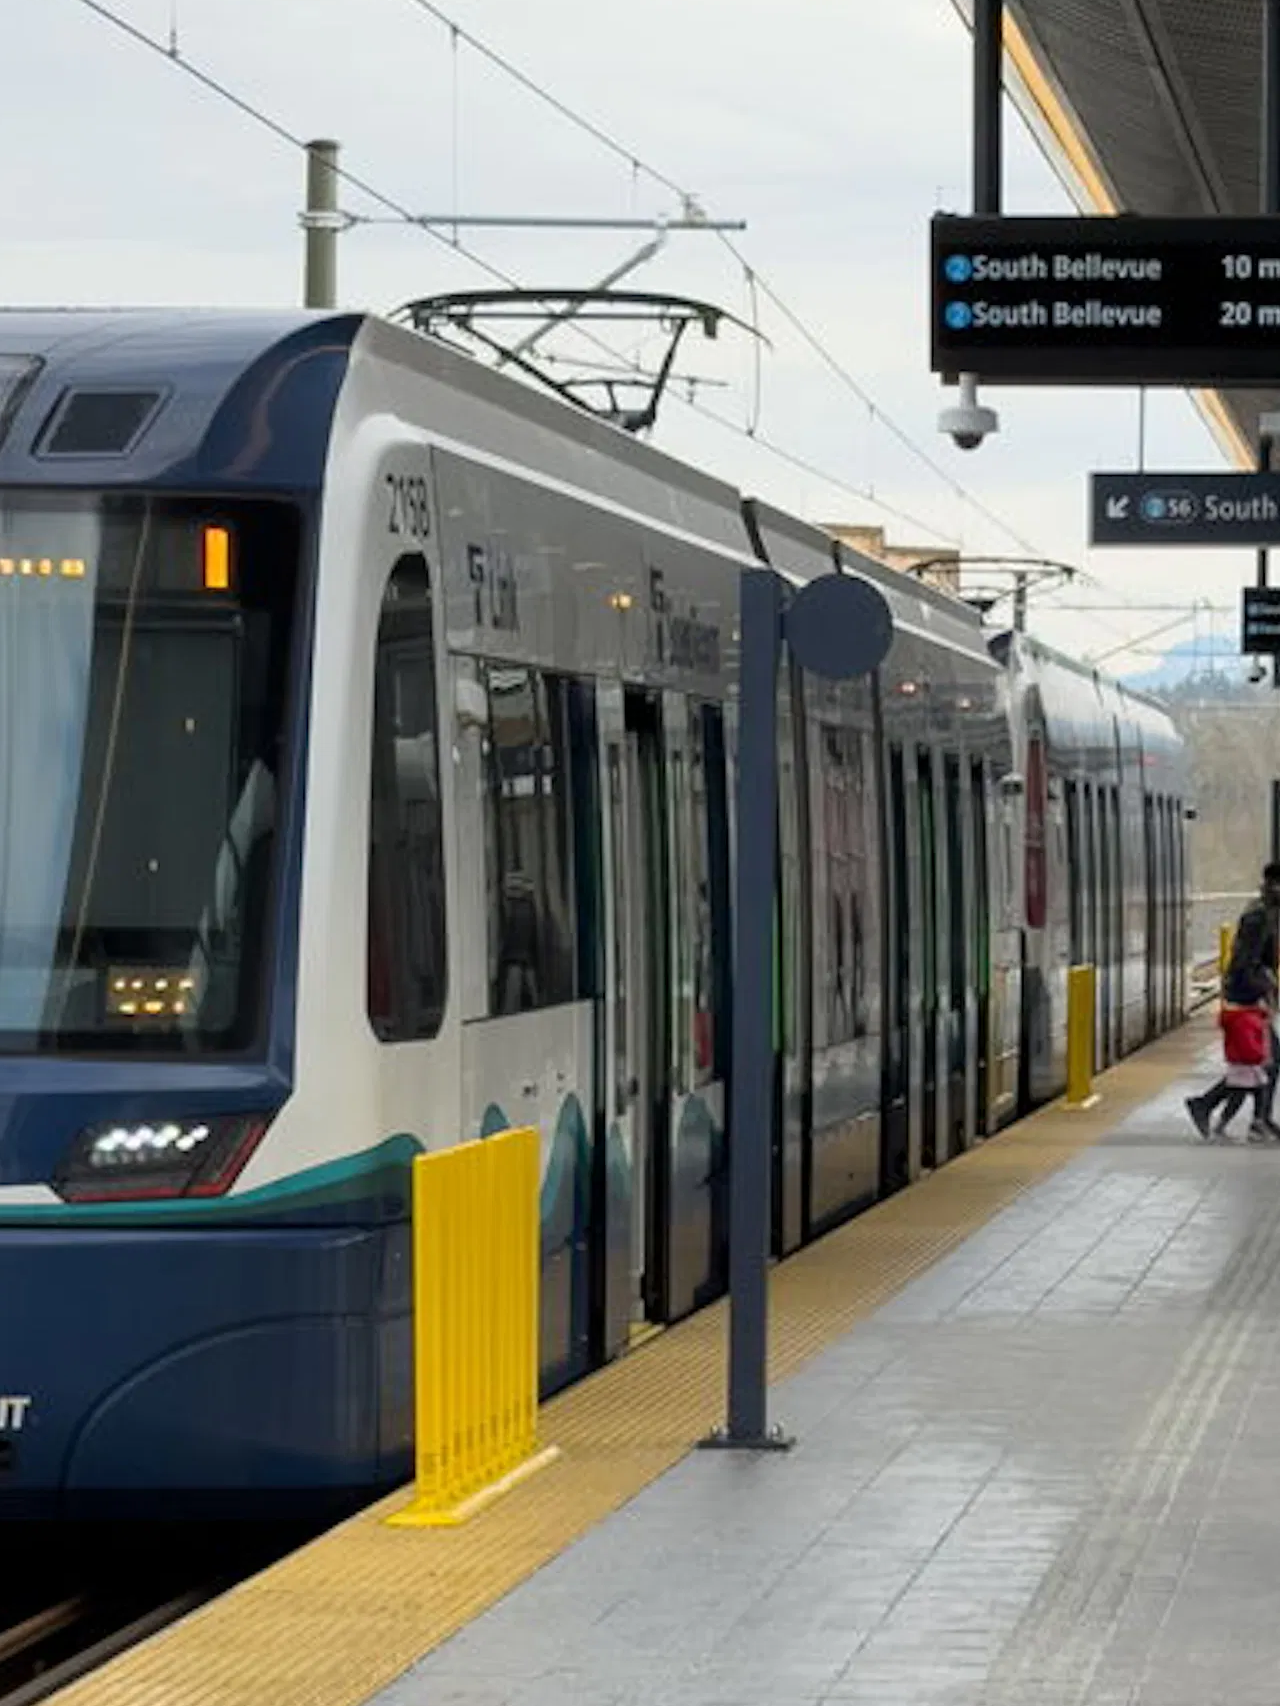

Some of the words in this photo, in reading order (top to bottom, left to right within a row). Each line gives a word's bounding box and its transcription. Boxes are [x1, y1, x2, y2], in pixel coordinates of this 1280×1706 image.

[972, 254, 1048, 280] South
[1053, 254, 1162, 280] Bellevue
[1221, 254, 1252, 280] 10
[972, 301, 1048, 327] South
[1053, 301, 1162, 327] Bellevue
[1220, 301, 1251, 327] 20
[1167, 497, 1192, 519] 56
[1204, 494, 1278, 521] South
